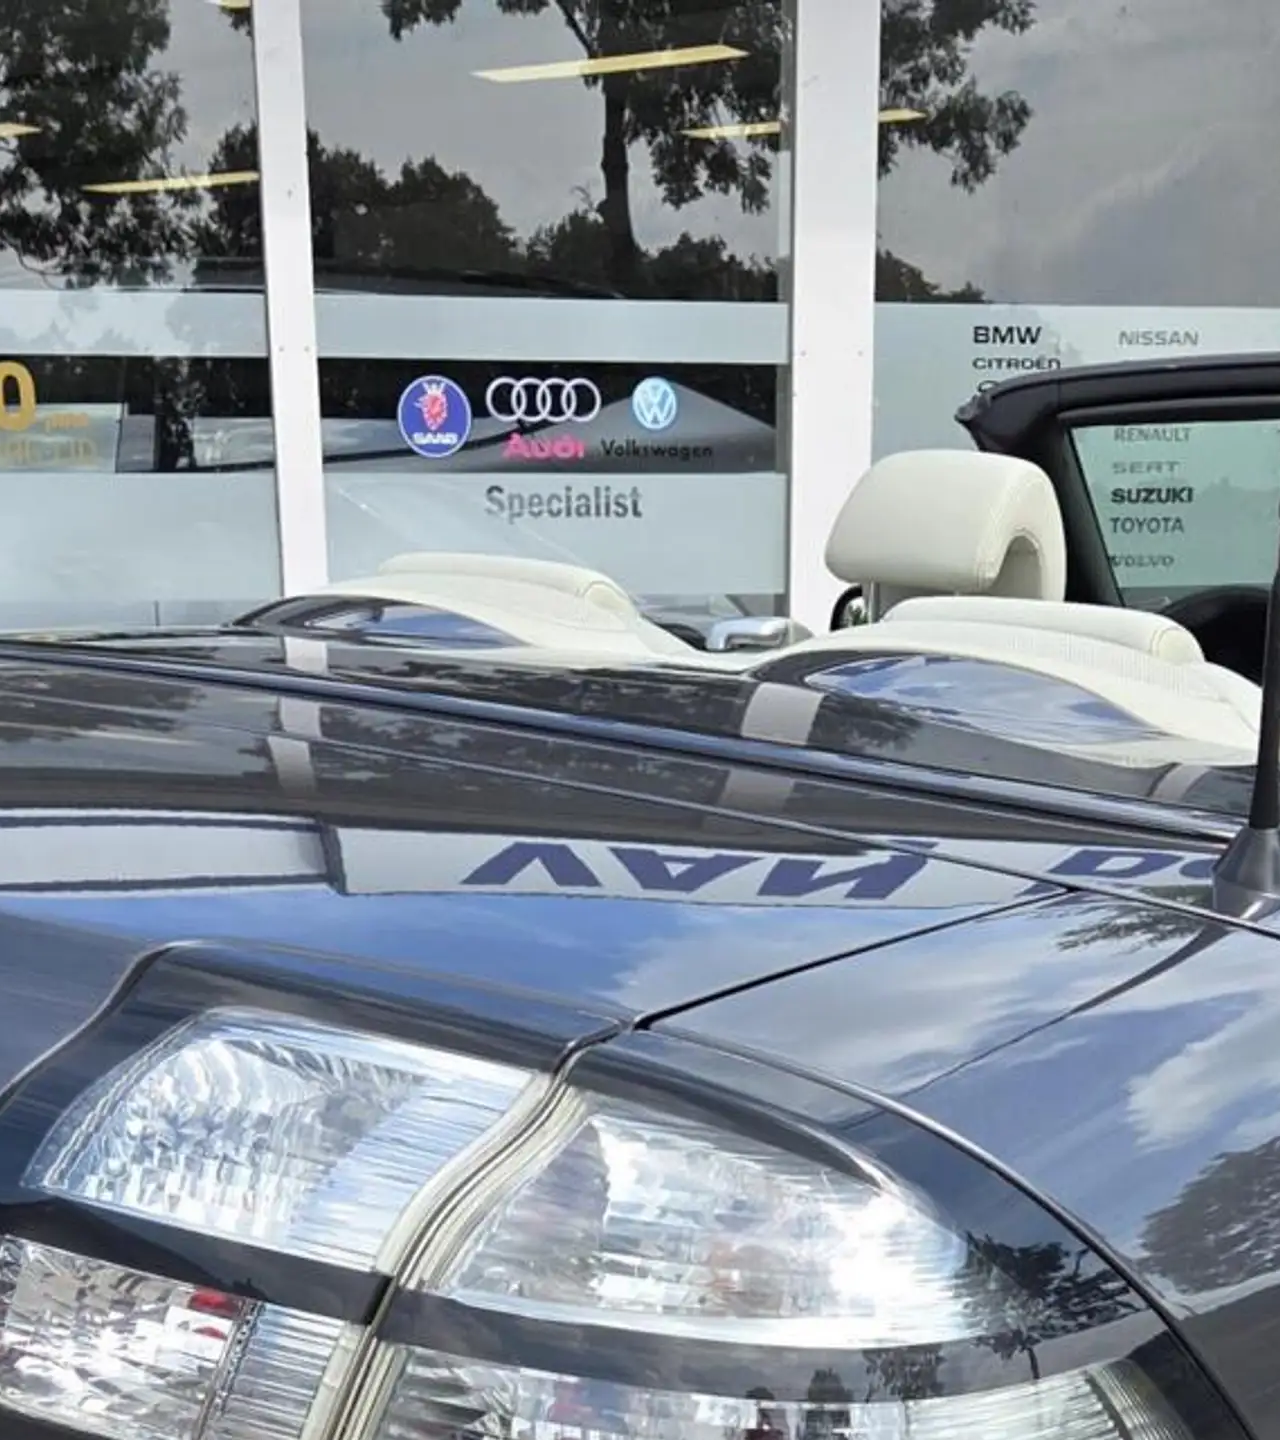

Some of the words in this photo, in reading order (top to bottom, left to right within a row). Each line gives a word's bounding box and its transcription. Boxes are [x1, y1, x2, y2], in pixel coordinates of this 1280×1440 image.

[973, 325, 1042, 345] BMW
[1118, 330, 1199, 346] NISSAN
[1113, 427, 1191, 442] RENAULT
[505, 432, 585, 459] Audi
[600, 436, 714, 459] Volkswagen
[1112, 461, 1180, 474] SEAT
[1110, 487, 1194, 504] SUZUKI
[485, 485, 643, 523] Specialist
[1110, 517, 1185, 533] TOYOTA
